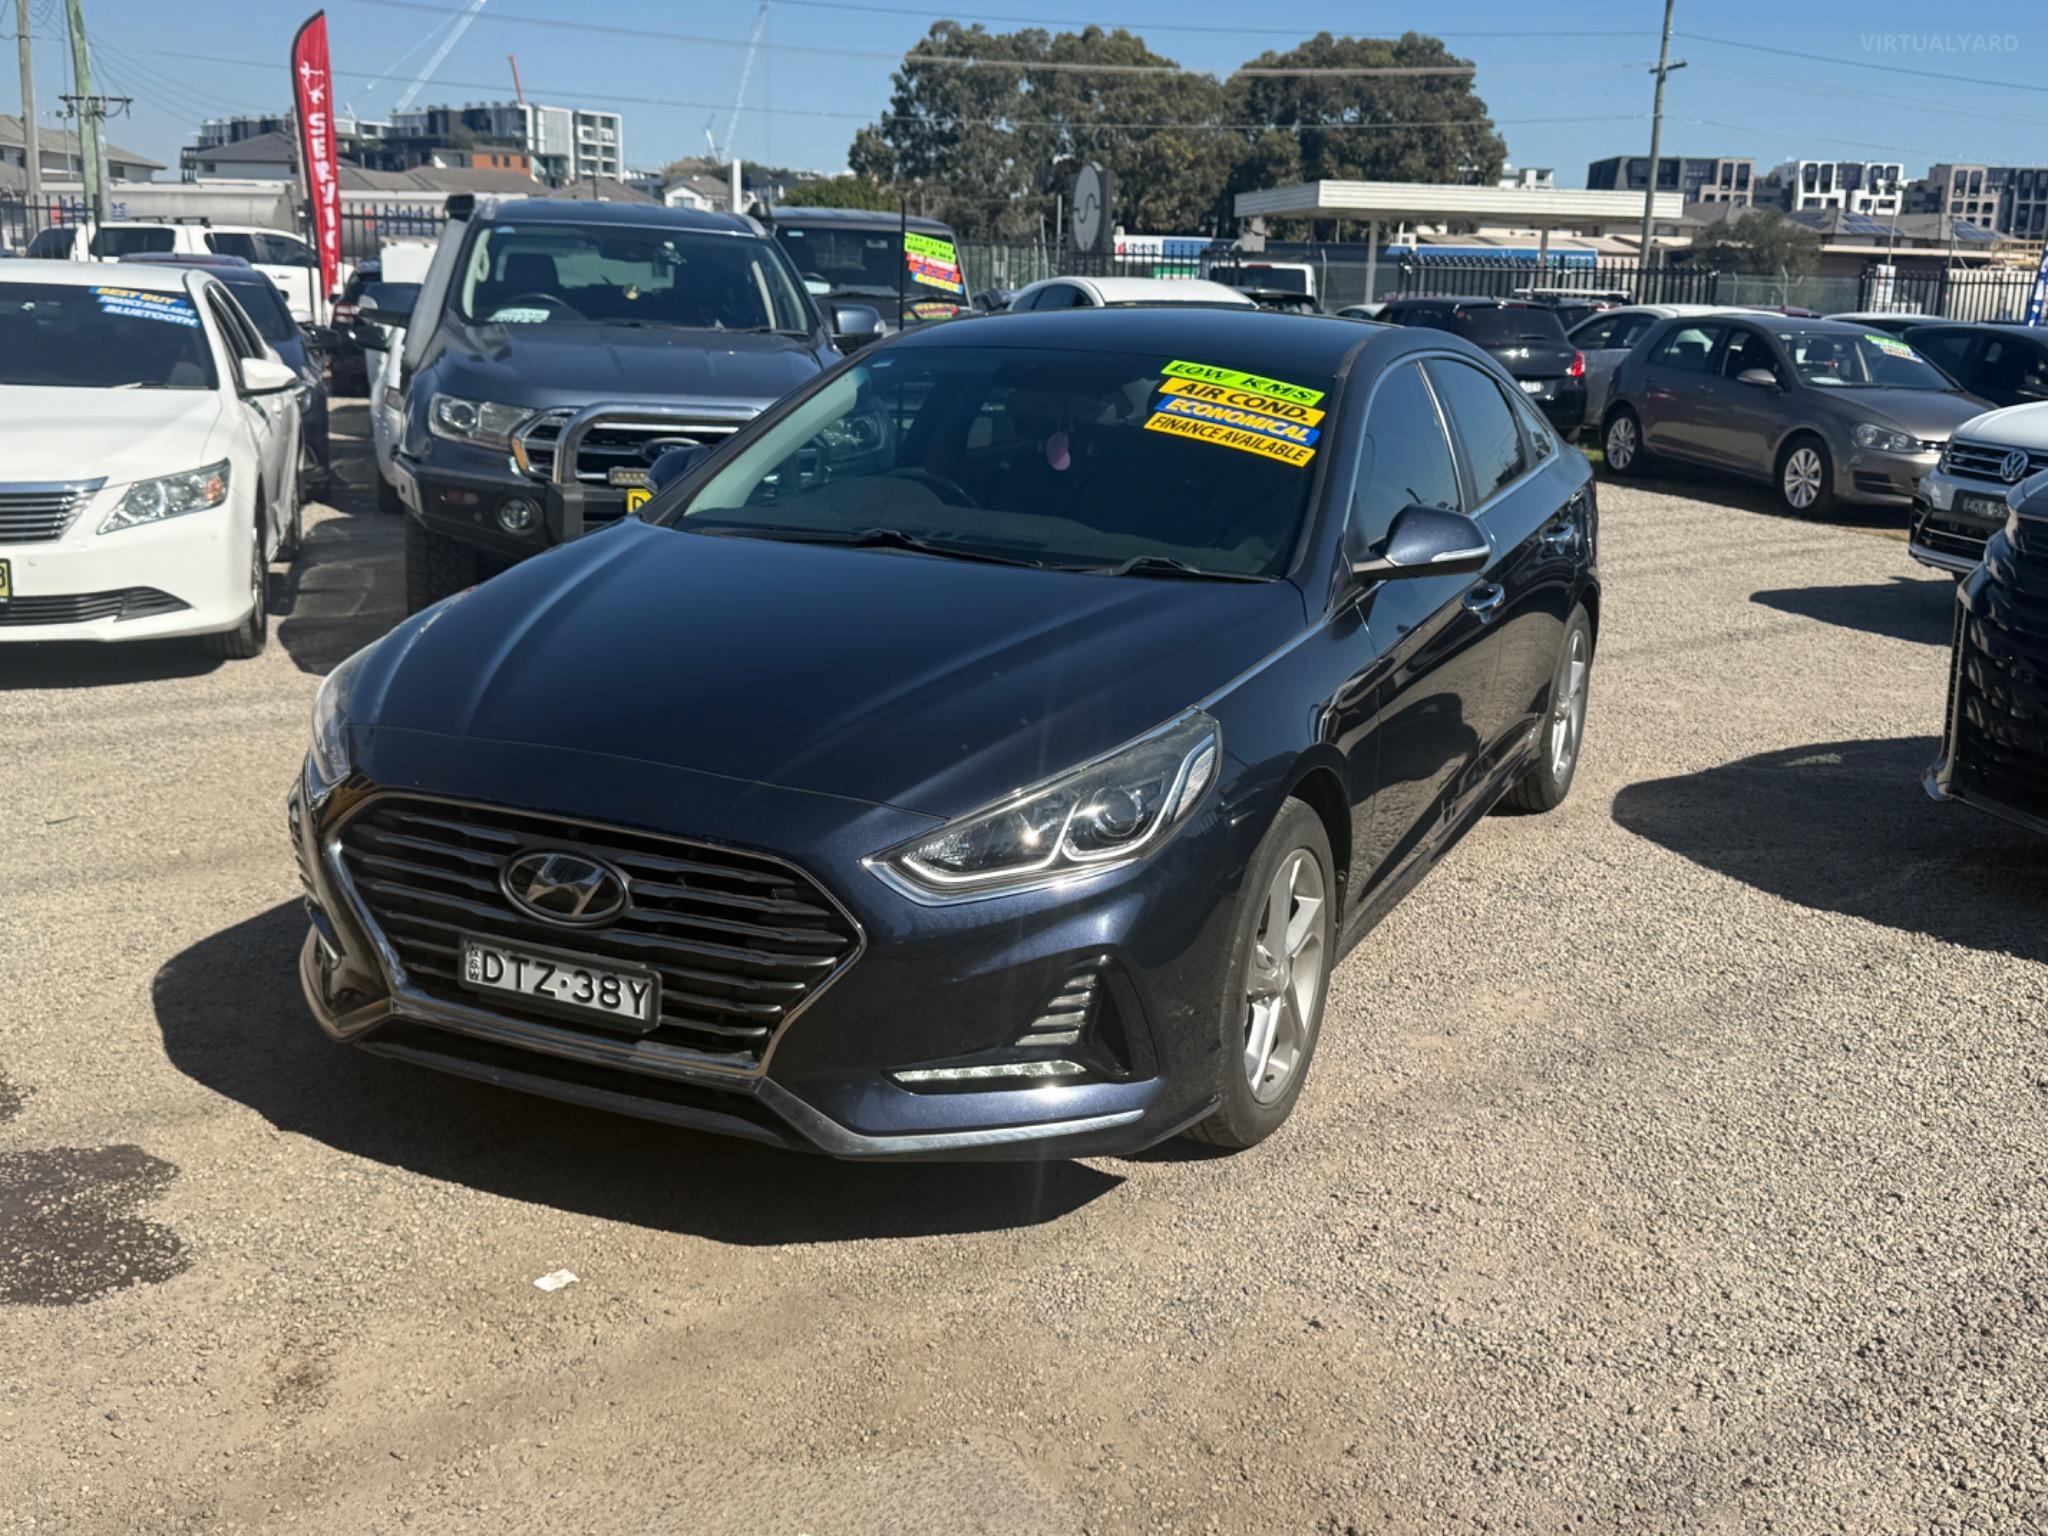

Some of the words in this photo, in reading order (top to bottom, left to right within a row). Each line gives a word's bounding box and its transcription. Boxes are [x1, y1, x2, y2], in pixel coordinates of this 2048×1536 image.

[96, 287, 141, 298] BEST
[141, 293, 178, 305] BUY
[103, 305, 198, 326] BLUETOOTH
[1169, 363, 1235, 380] LOW
[1241, 377, 1316, 401] KMS
[1165, 398, 1310, 442] ECONOMICAL
[1176, 383, 1225, 400] AIR
[1227, 392, 1309, 422] COND.
[1152, 416, 1220, 439] FINANCE
[1218, 431, 1309, 461] AVAILABLE
